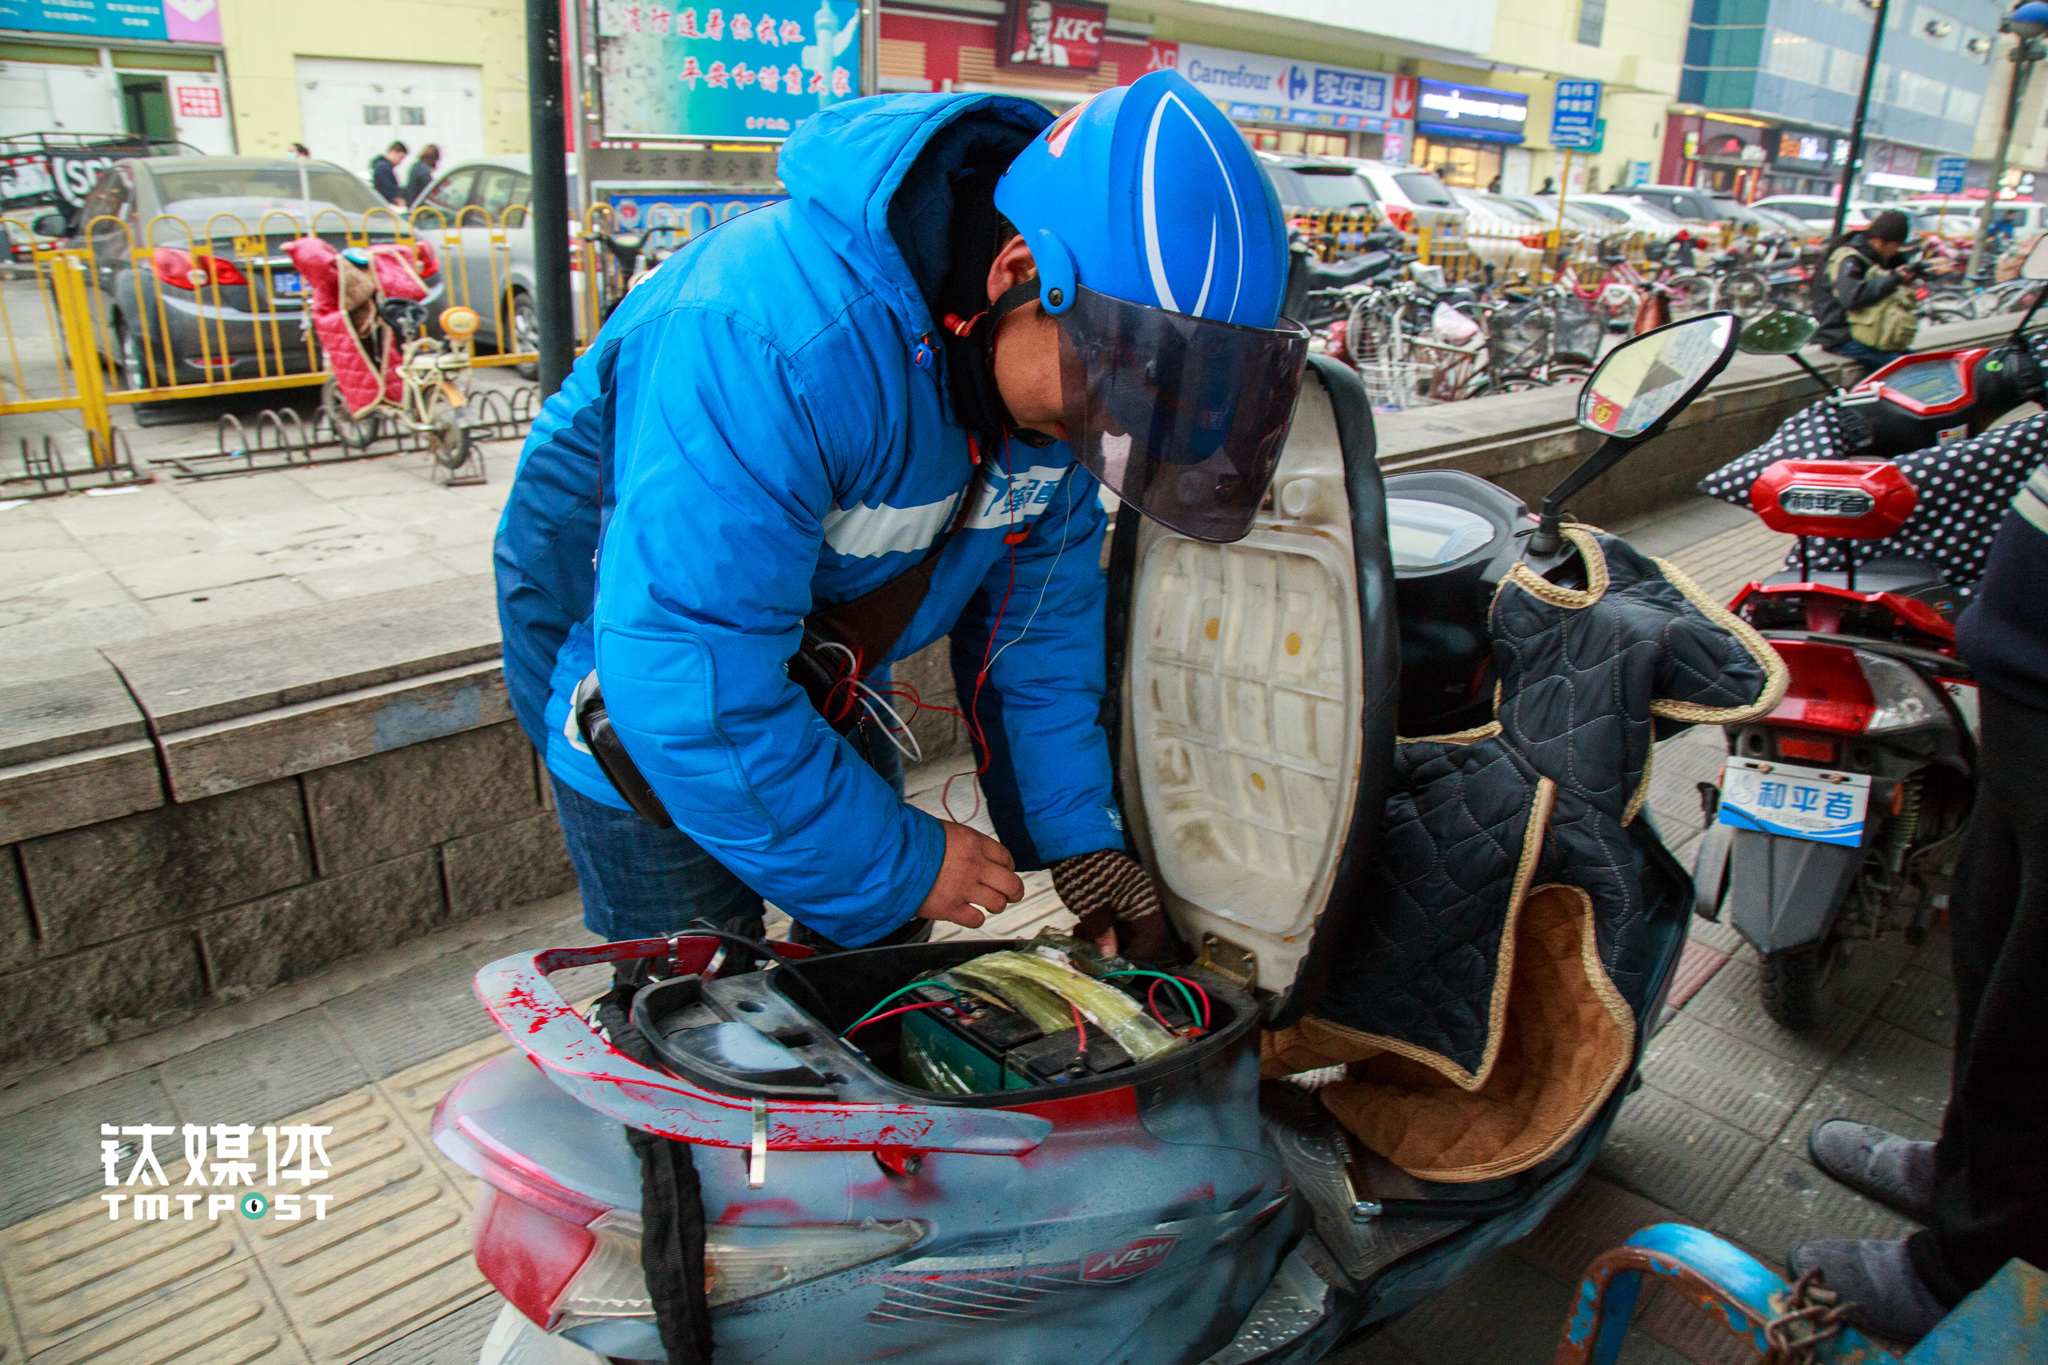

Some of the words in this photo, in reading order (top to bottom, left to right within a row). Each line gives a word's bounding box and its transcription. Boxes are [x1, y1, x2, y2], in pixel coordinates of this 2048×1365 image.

[1053, 17, 1102, 44] KFC
[1147, 46, 1176, 72] 入口
[1187, 59, 1272, 92] Carrefour
[1316, 72, 1384, 109] 家乐福
[1790, 492, 1862, 513] 和平者
[1757, 781, 1854, 820] 和平者
[1088, 1241, 1172, 1274] NEW
